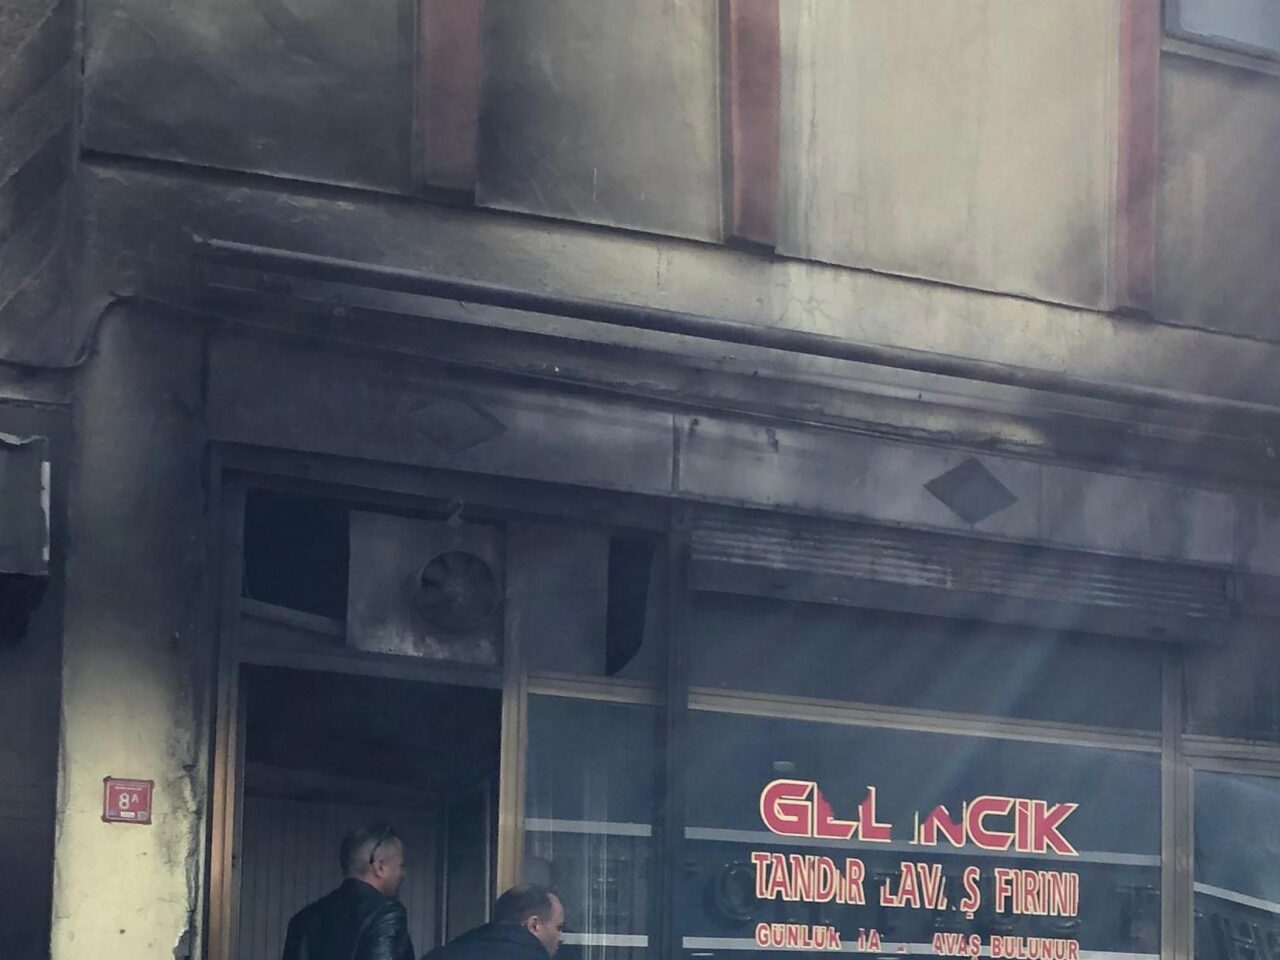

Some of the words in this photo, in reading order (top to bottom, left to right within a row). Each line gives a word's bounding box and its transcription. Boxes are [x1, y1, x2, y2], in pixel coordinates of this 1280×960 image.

[761, 779, 1080, 856] GLNCİK
[880, 862, 981, 919] LAVŞ
[994, 868, 1080, 917] FIRINI
